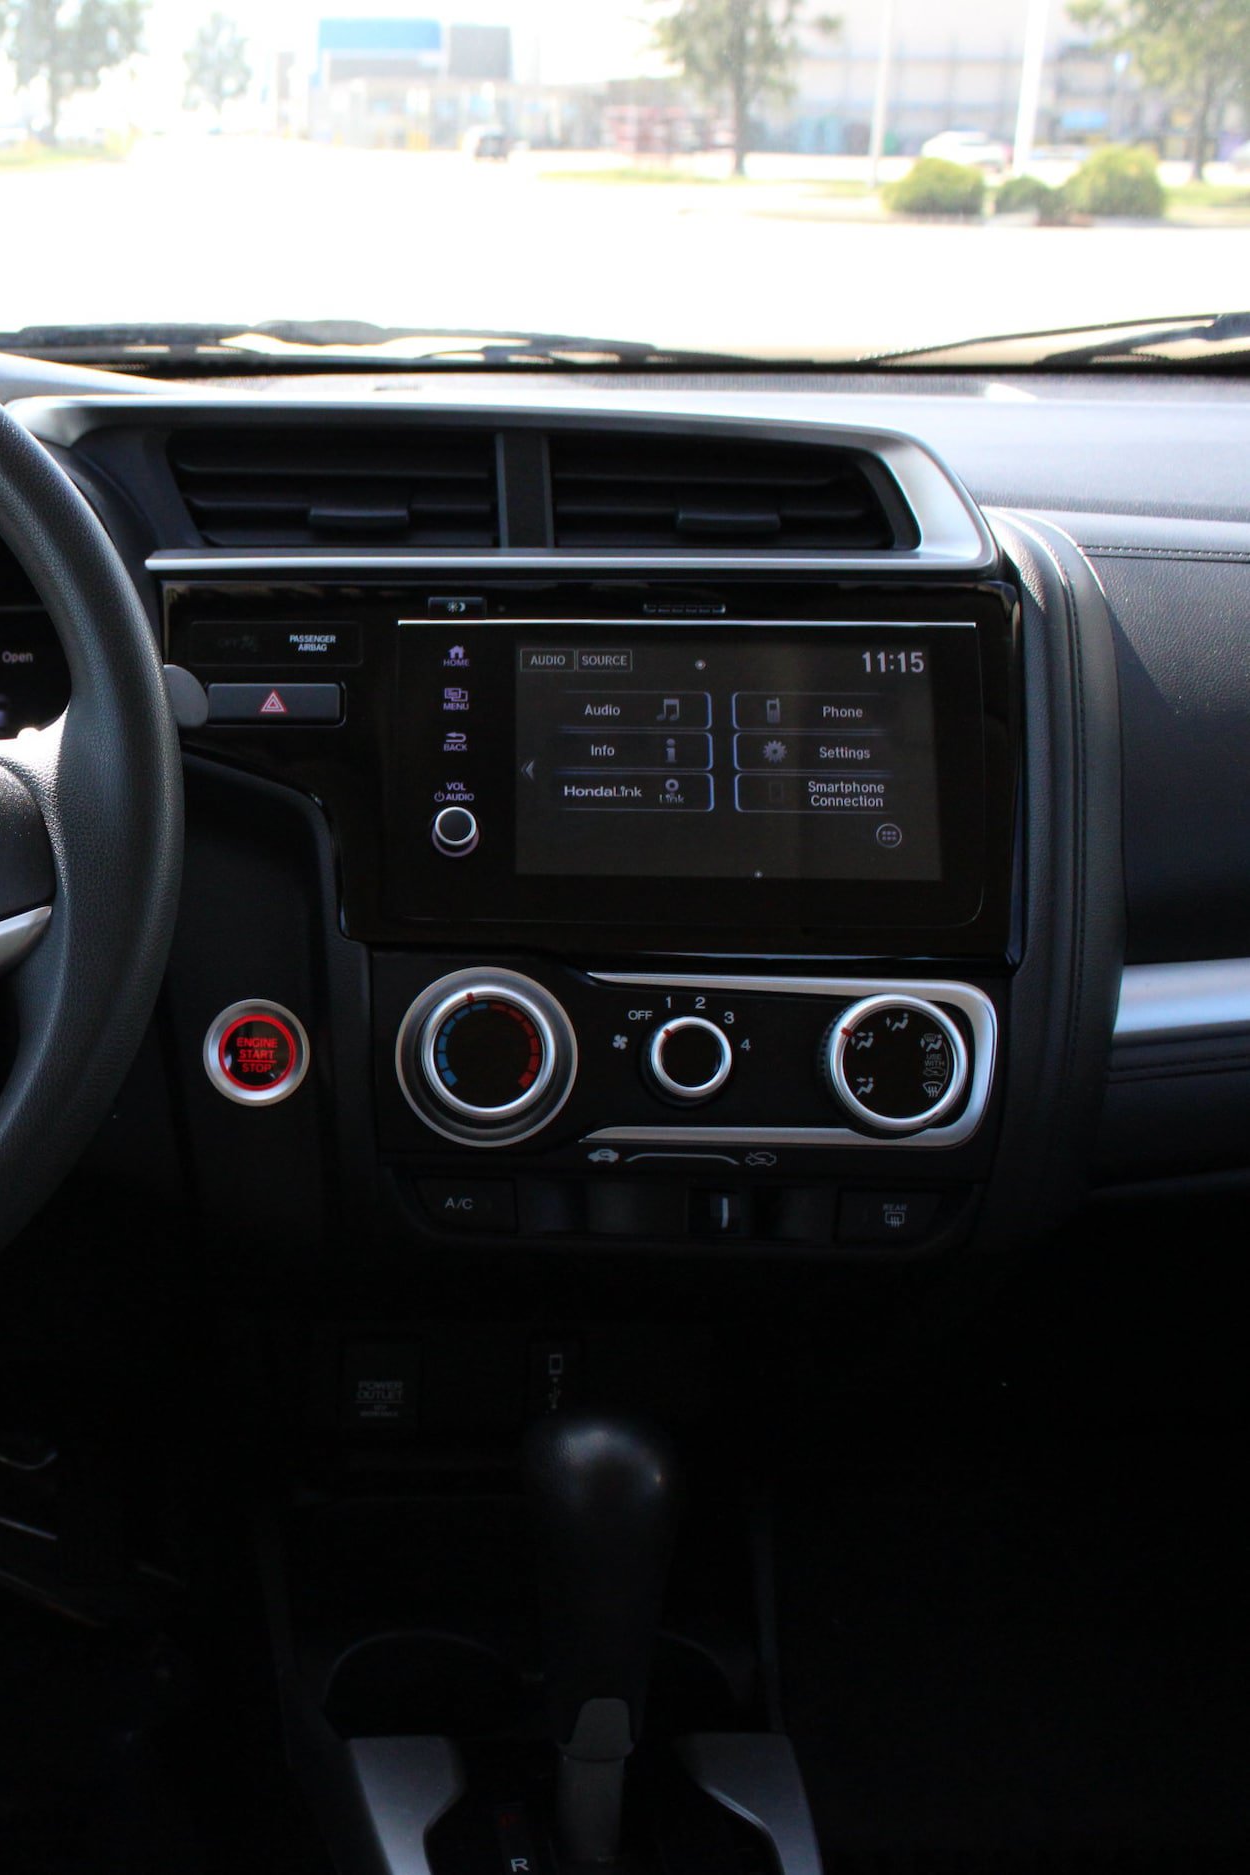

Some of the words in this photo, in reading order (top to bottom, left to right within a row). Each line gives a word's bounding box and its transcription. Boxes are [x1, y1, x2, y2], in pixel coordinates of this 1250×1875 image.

[289, 634, 336, 644] PASSENGER
[297, 643, 328, 652] AIRBAG
[2, 650, 34, 665] Open
[443, 658, 470, 667] HOME
[530, 654, 566, 667] AUDIO
[581, 654, 628, 667] SOURCE
[862, 651, 925, 673] 11:15
[442, 702, 469, 711] MENU
[584, 703, 621, 716] Audio
[822, 705, 863, 718] Phone
[443, 743, 468, 752] BACK
[590, 744, 615, 757] Info
[819, 746, 871, 760] Settings
[445, 782, 467, 791] VOL
[563, 785, 642, 798] HondaLink
[807, 781, 885, 794] Smartphone
[445, 792, 475, 801] AUDIO
[810, 794, 884, 807] Connection
[665, 995, 672, 1009] 1
[694, 996, 706, 1010] 2
[628, 1009, 653, 1021] OFF
[723, 1011, 735, 1025] 3
[236, 1038, 278, 1049] ENGINE
[740, 1038, 751, 1051] 4
[239, 1049, 274, 1059] START
[242, 1063, 272, 1073] STOP
[444, 1197, 473, 1210] A/C
[510, 1858, 530, 1873] R
